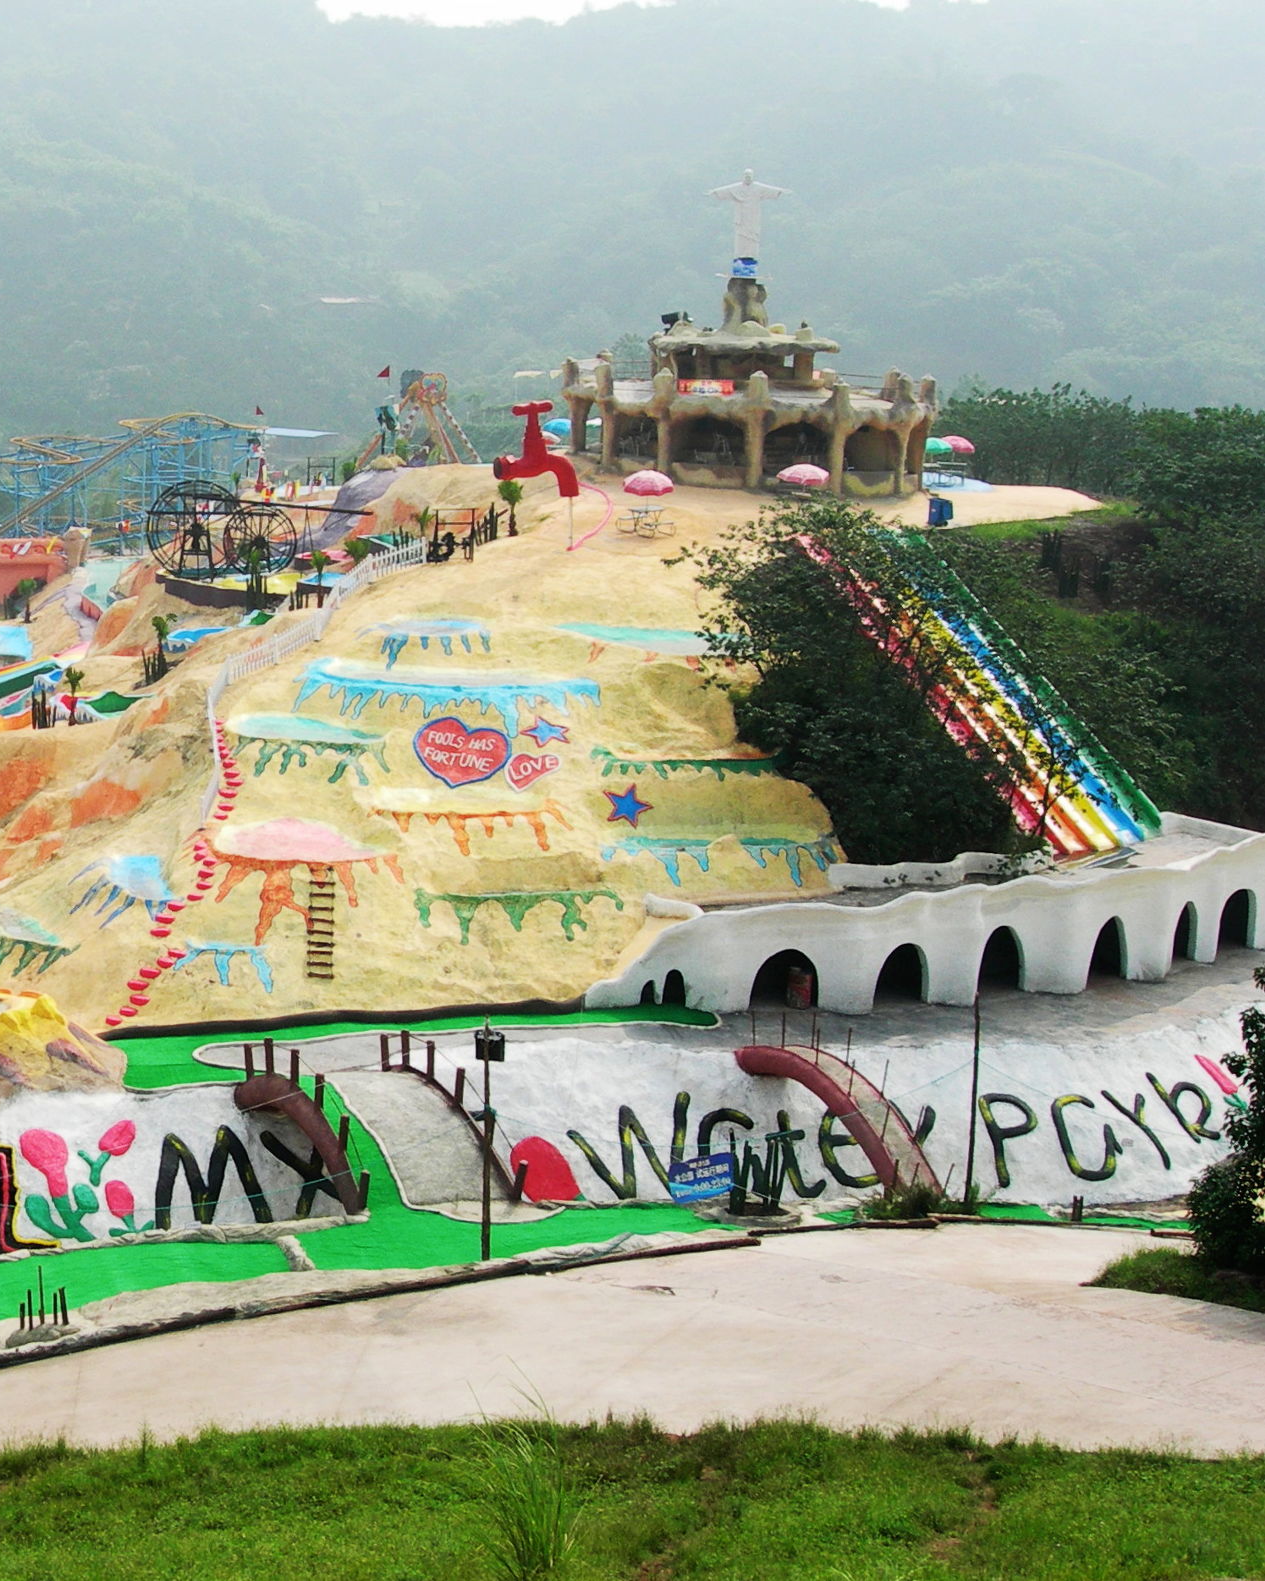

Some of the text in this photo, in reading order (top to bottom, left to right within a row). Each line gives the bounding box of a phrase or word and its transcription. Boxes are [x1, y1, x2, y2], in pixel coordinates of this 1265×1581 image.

[428, 731, 496, 751] FOOLS HAS
[423, 747, 494, 772] FORTUNE
[509, 756, 560, 780] LOVE
